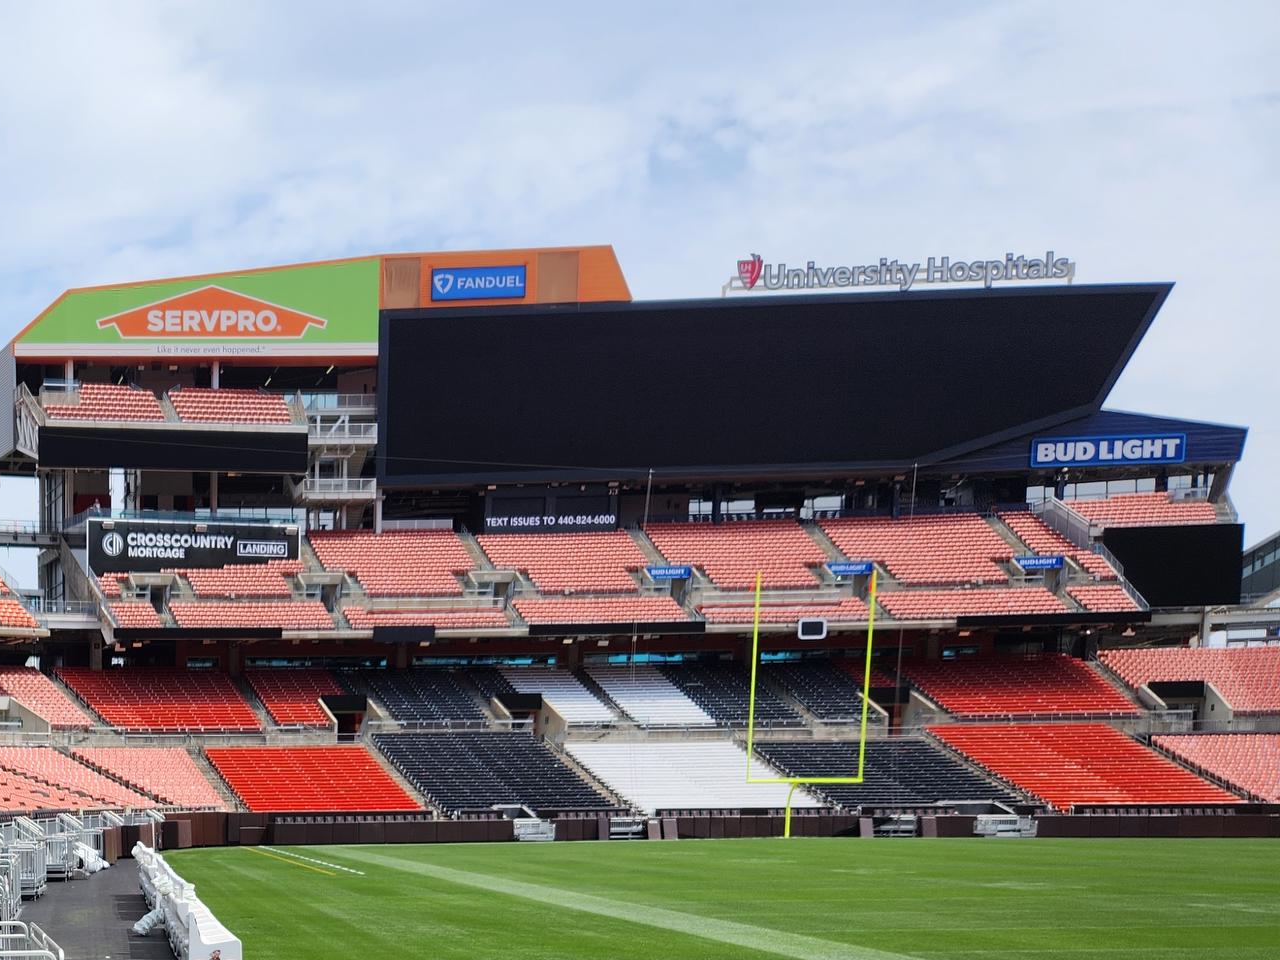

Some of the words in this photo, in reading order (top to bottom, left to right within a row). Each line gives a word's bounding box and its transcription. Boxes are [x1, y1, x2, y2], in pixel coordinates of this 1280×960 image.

[763, 255, 920, 292] University
[927, 250, 1070, 288] Hospitals
[457, 275, 524, 289] FANDUEL
[157, 346, 172, 354] Like
[1036, 441, 1096, 463] BUD
[1098, 438, 1181, 461] LIGHT
[485, 517, 508, 526] TEXT
[510, 516, 540, 526] ISSUES
[542, 516, 556, 525] TO
[557, 514, 616, 525] 440-824-6000
[127, 532, 234, 549] CROSSCOUNTRY
[127, 546, 186, 559] MORTGAGE
[239, 544, 285, 555] LANDING
